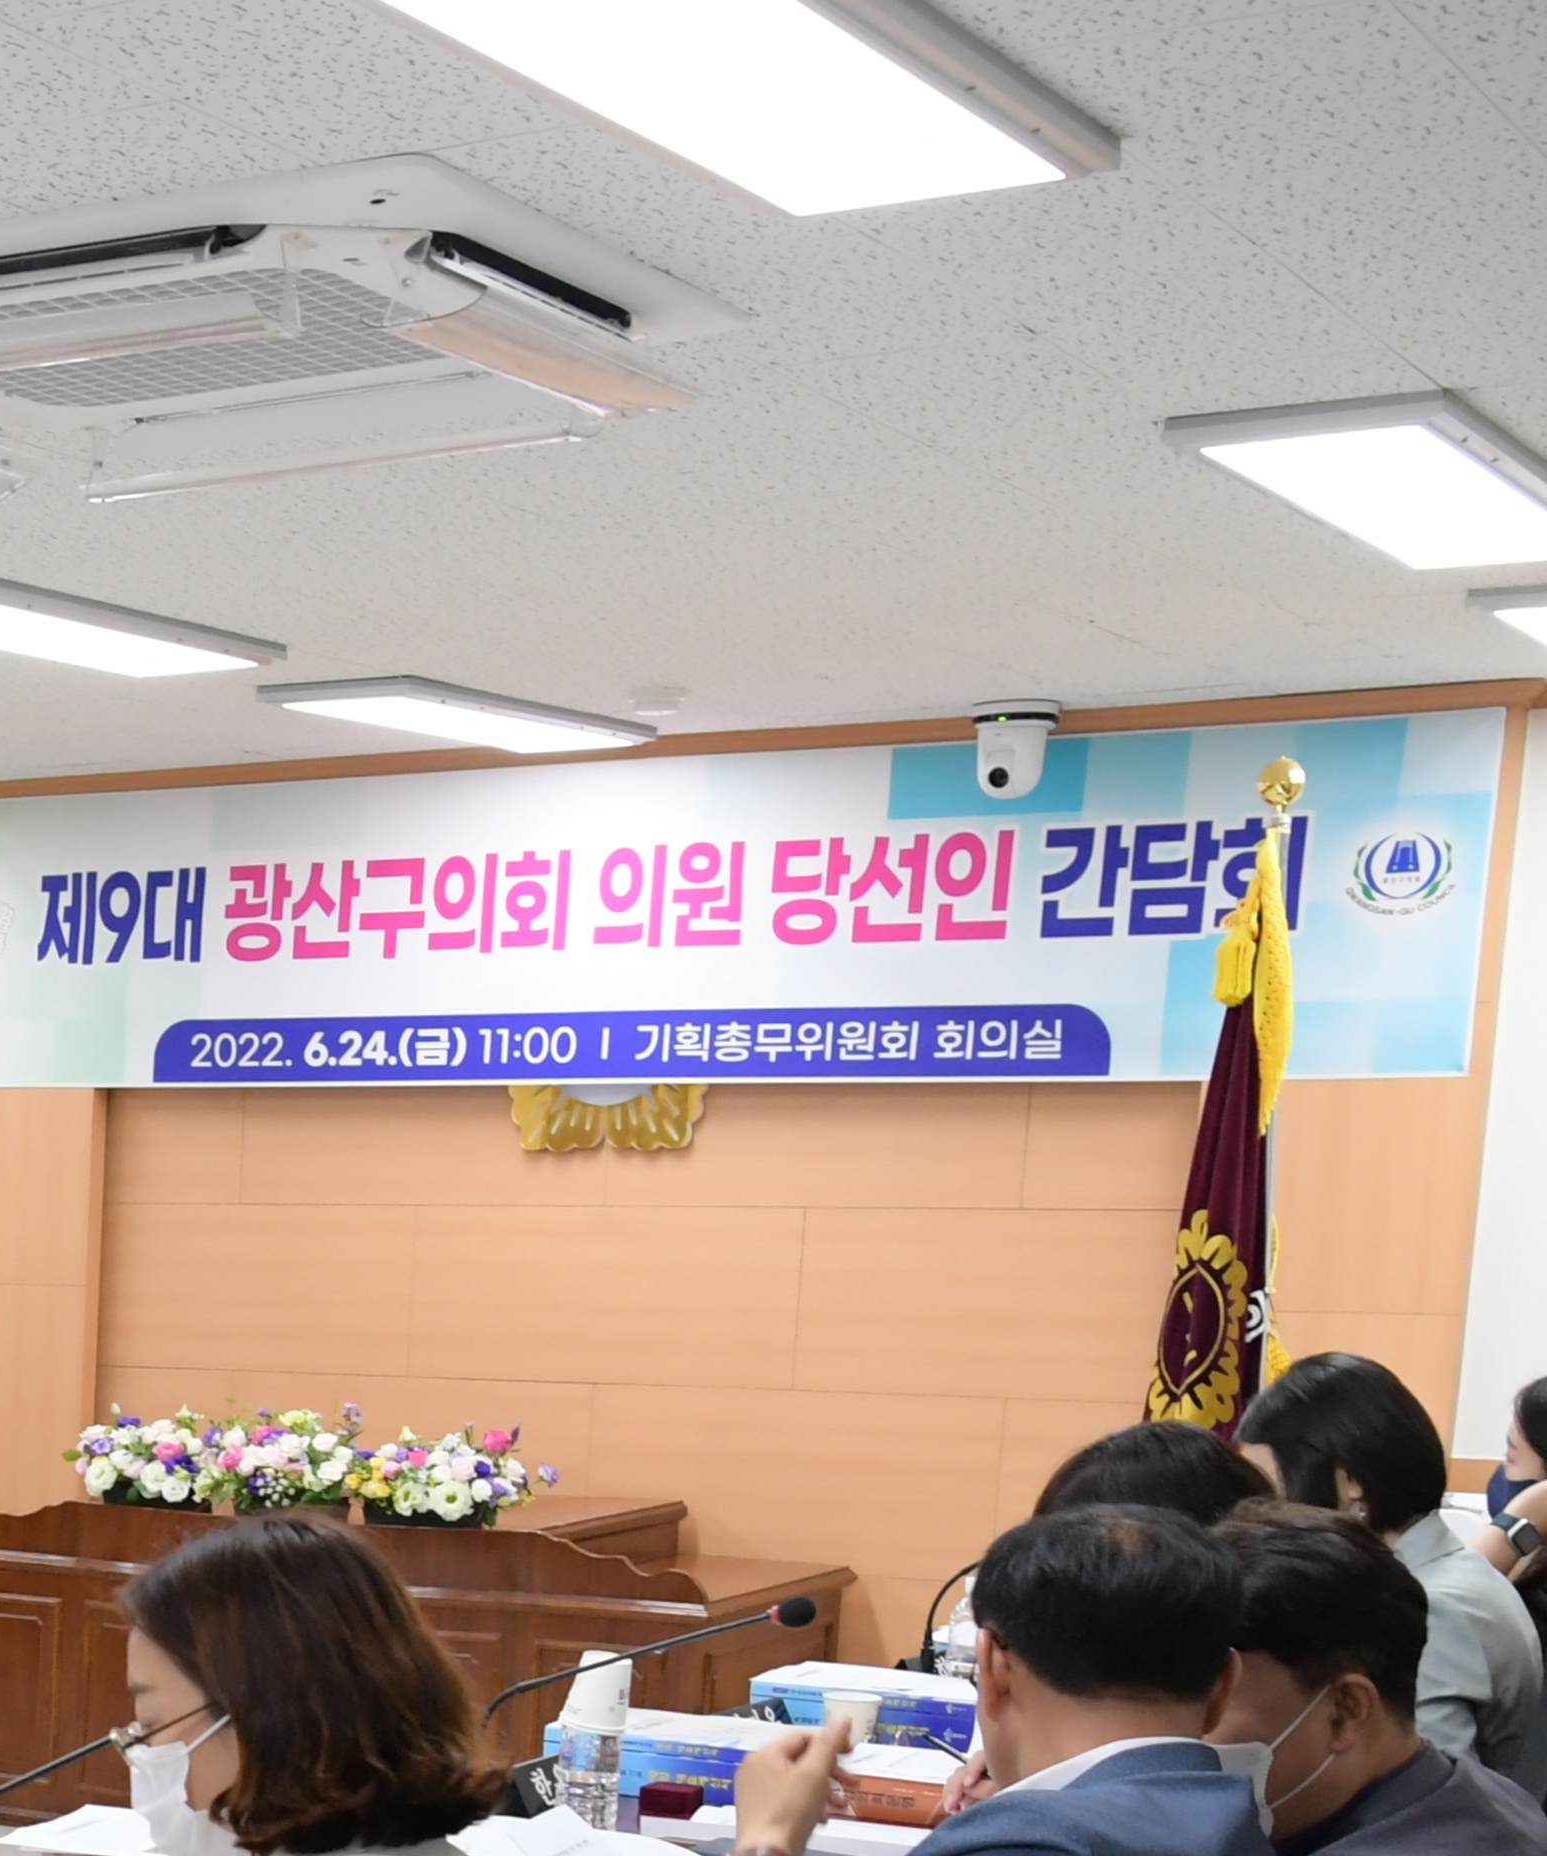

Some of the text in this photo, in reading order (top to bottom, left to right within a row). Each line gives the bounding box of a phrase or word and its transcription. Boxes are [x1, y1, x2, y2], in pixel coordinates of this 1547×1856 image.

[37, 868, 206, 965] 제9대
[224, 849, 572, 963] 광산구의회
[593, 840, 746, 948] 의원
[771, 830, 1016, 945] 당선인
[190, 1018, 1063, 1068] 2022. 6.24.(금) 11:00 기획총무위원회 회의실
